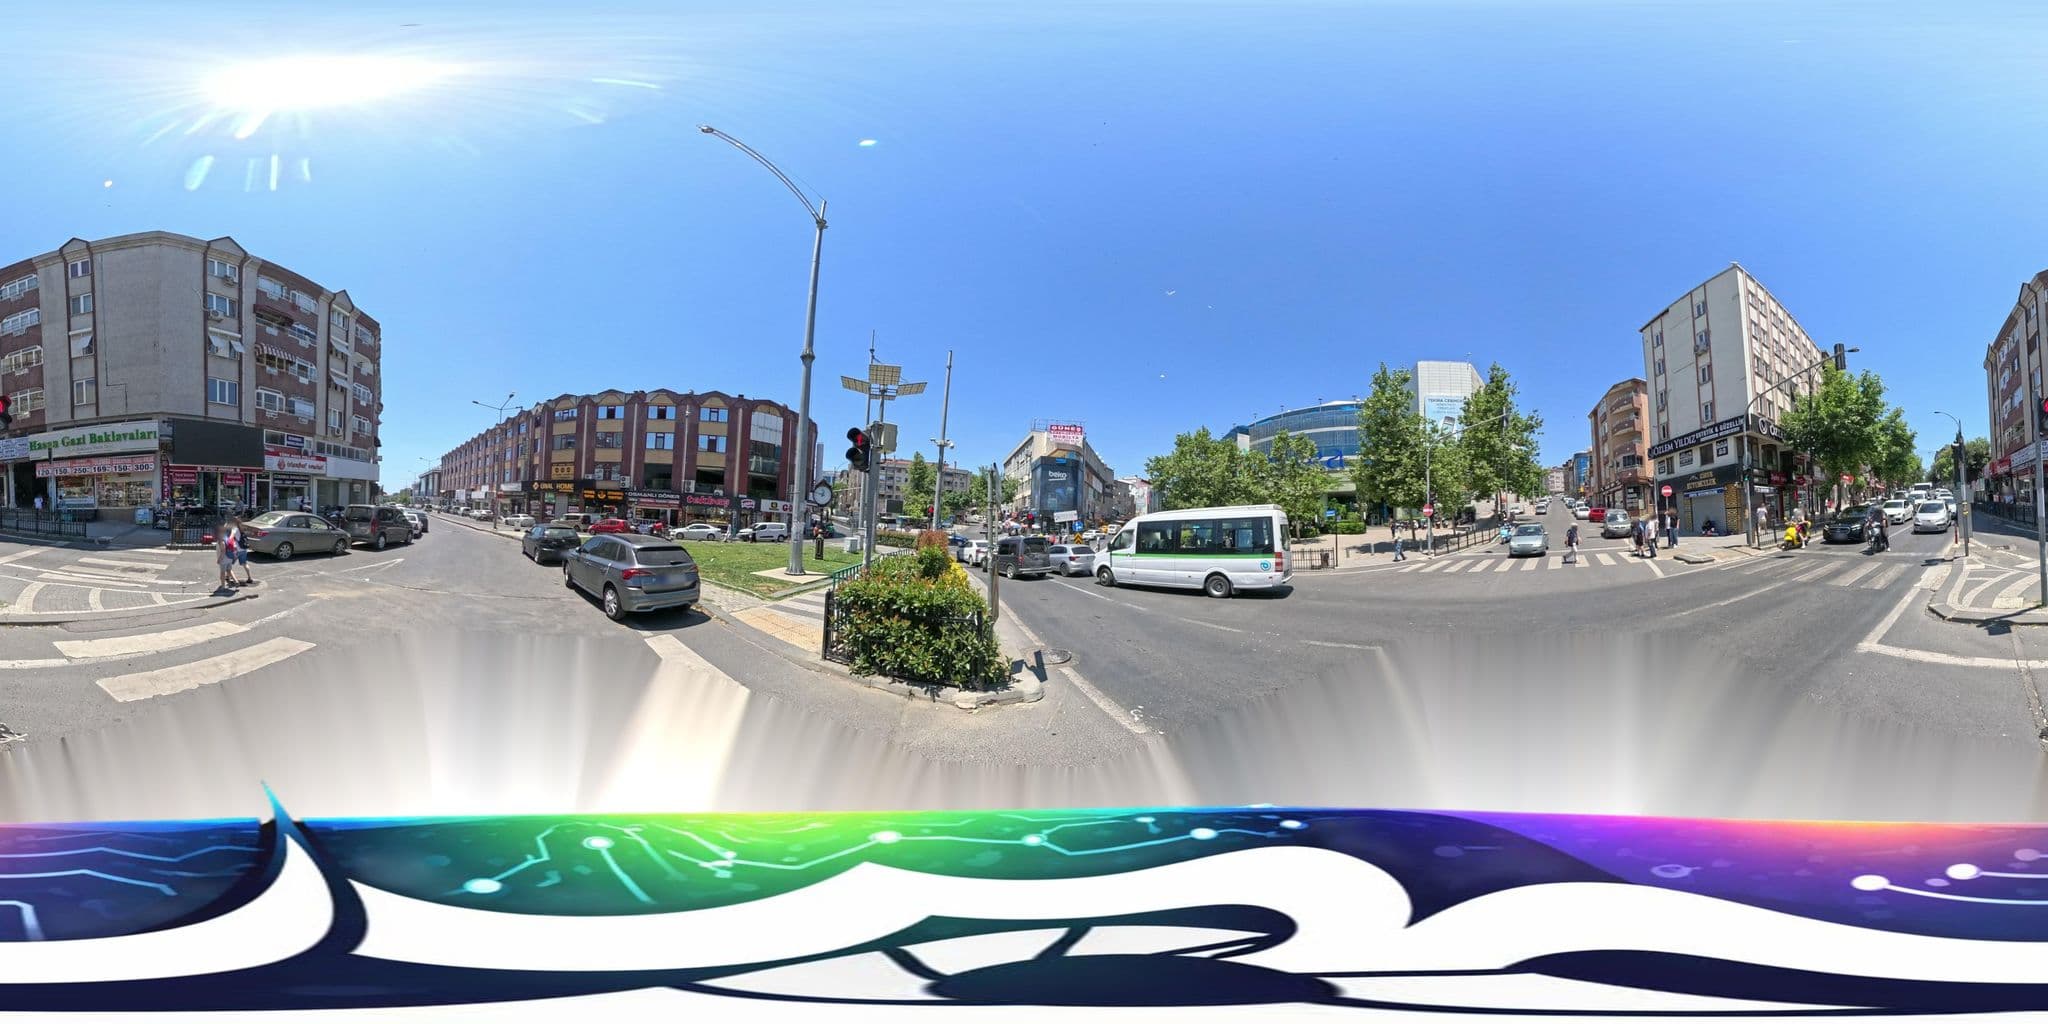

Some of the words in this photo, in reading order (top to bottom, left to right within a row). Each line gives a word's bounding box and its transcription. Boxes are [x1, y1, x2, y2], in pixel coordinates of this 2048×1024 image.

[61, 433, 86, 447] Gazi
[89, 428, 157, 444] Baklavaları
[1653, 443, 1674, 455] ÖZLEM
[1673, 434, 1697, 448] YILDIZ
[1048, 470, 1067, 478] beko
